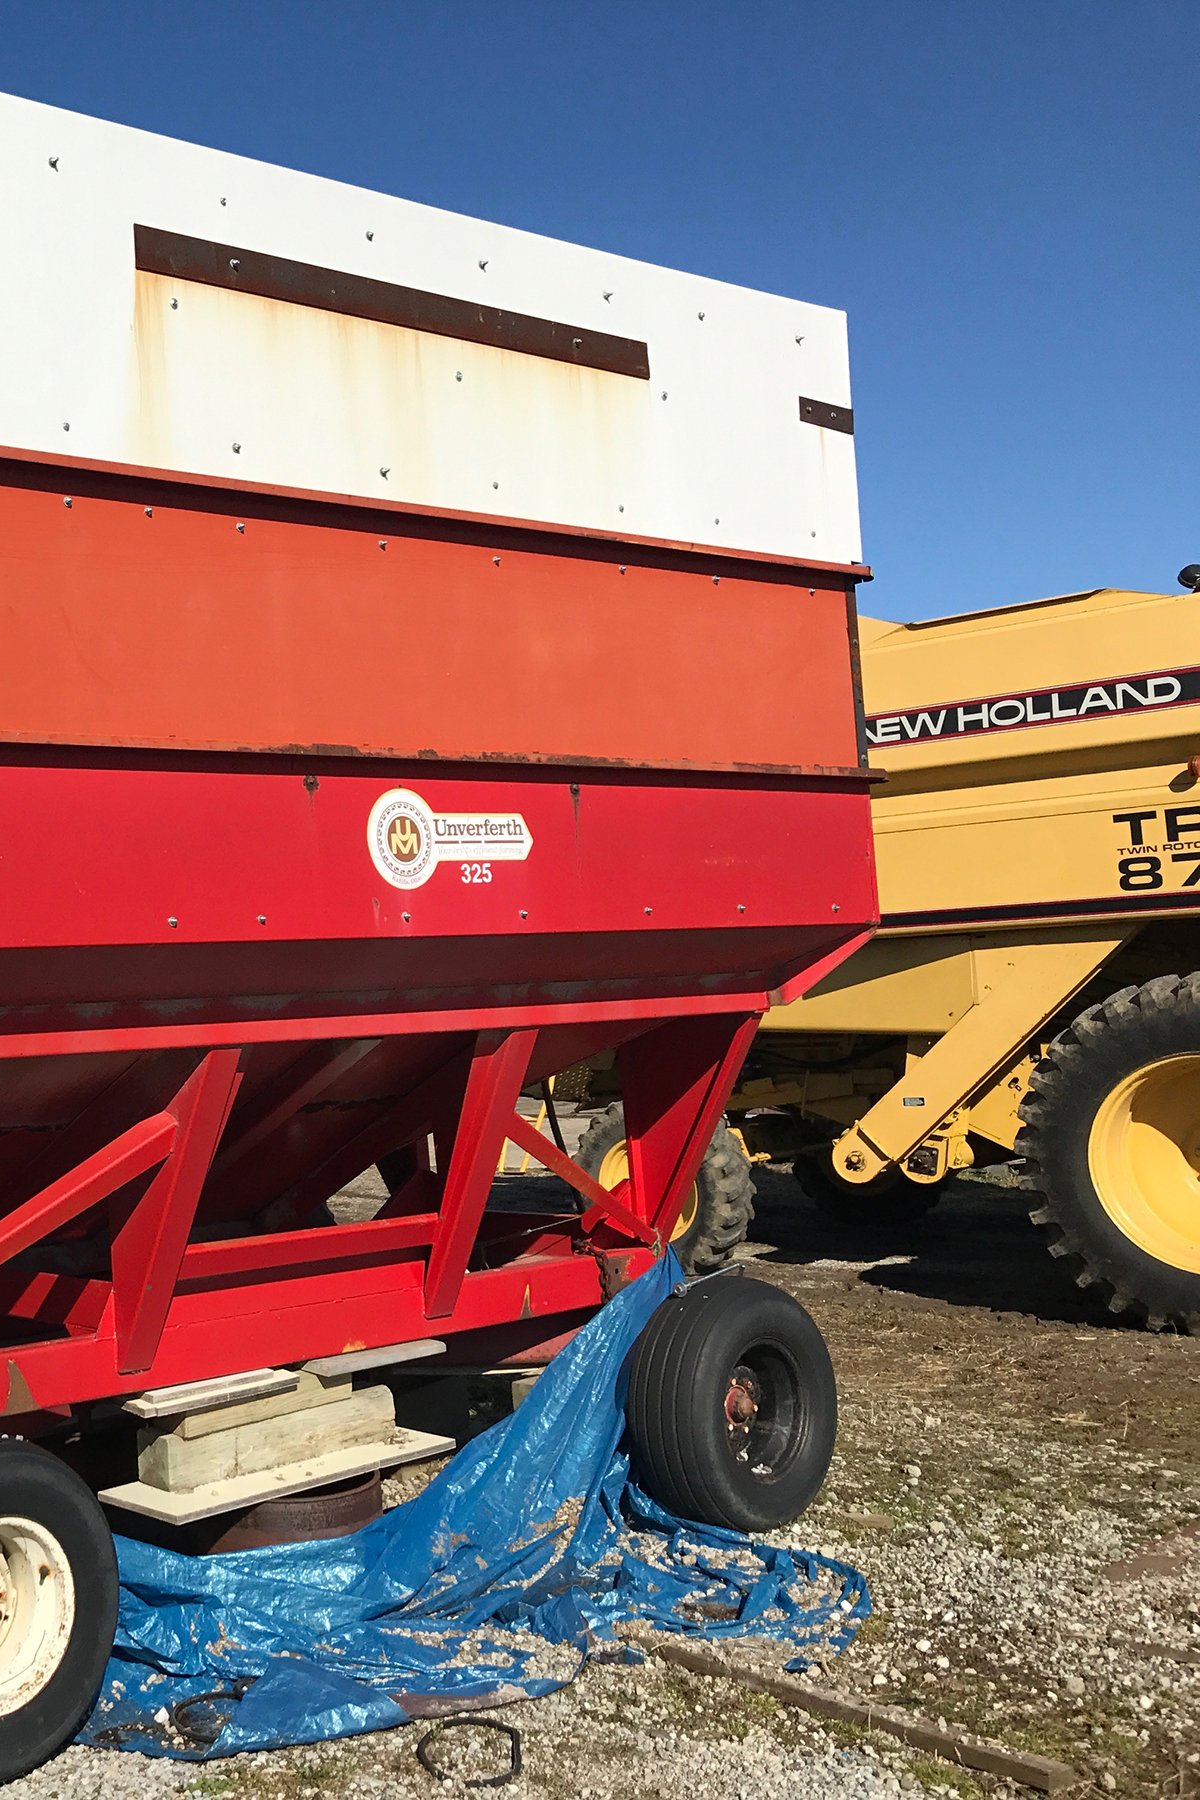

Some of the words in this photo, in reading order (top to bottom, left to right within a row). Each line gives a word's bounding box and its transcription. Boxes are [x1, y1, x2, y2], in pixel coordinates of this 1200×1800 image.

[957, 676, 1182, 732] HOLLAND
[433, 819, 524, 836] Unverferth
[1117, 845, 1158, 856] TWIN
[460, 862, 493, 884] 325
[1118, 852, 1200, 891] 87
